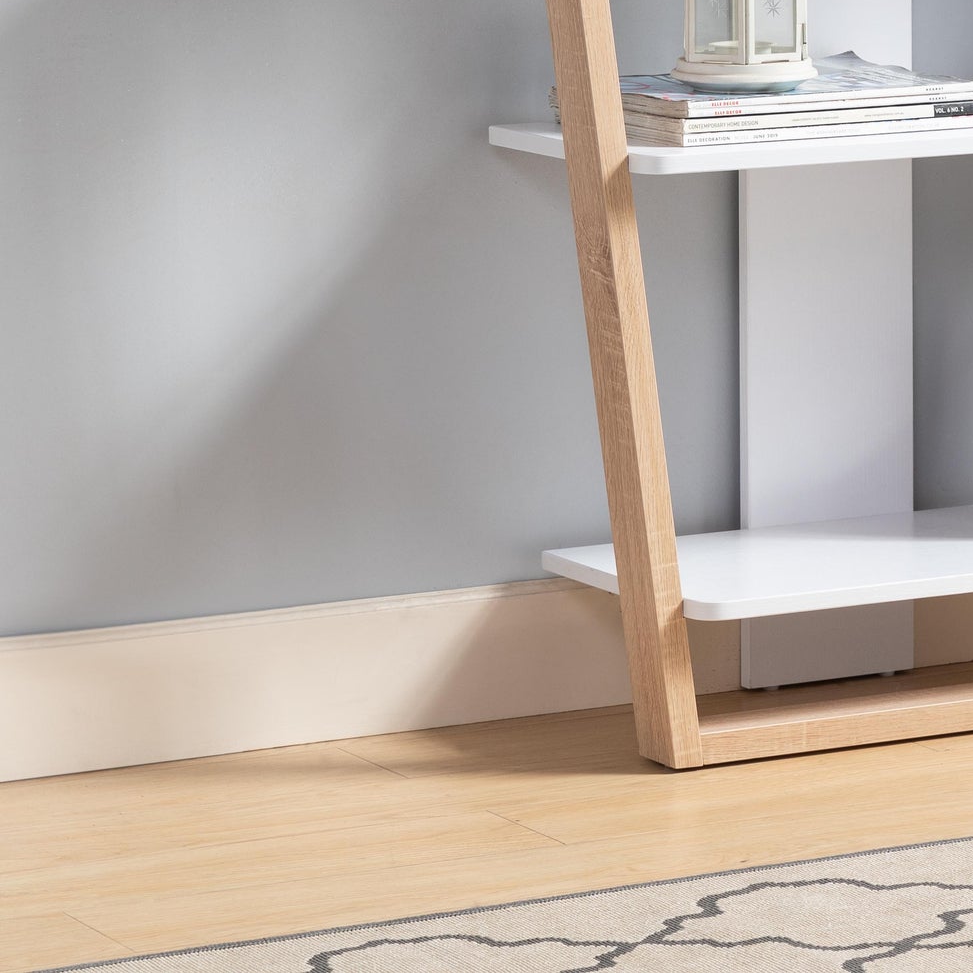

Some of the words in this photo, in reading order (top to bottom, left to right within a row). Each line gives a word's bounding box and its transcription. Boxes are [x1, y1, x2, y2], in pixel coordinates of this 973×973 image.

[934, 107, 946, 115] VOL.
[688, 121, 726, 130] CONTEMPORARY
[726, 120, 740, 128] HOME
[741, 119, 759, 127] DESIGN
